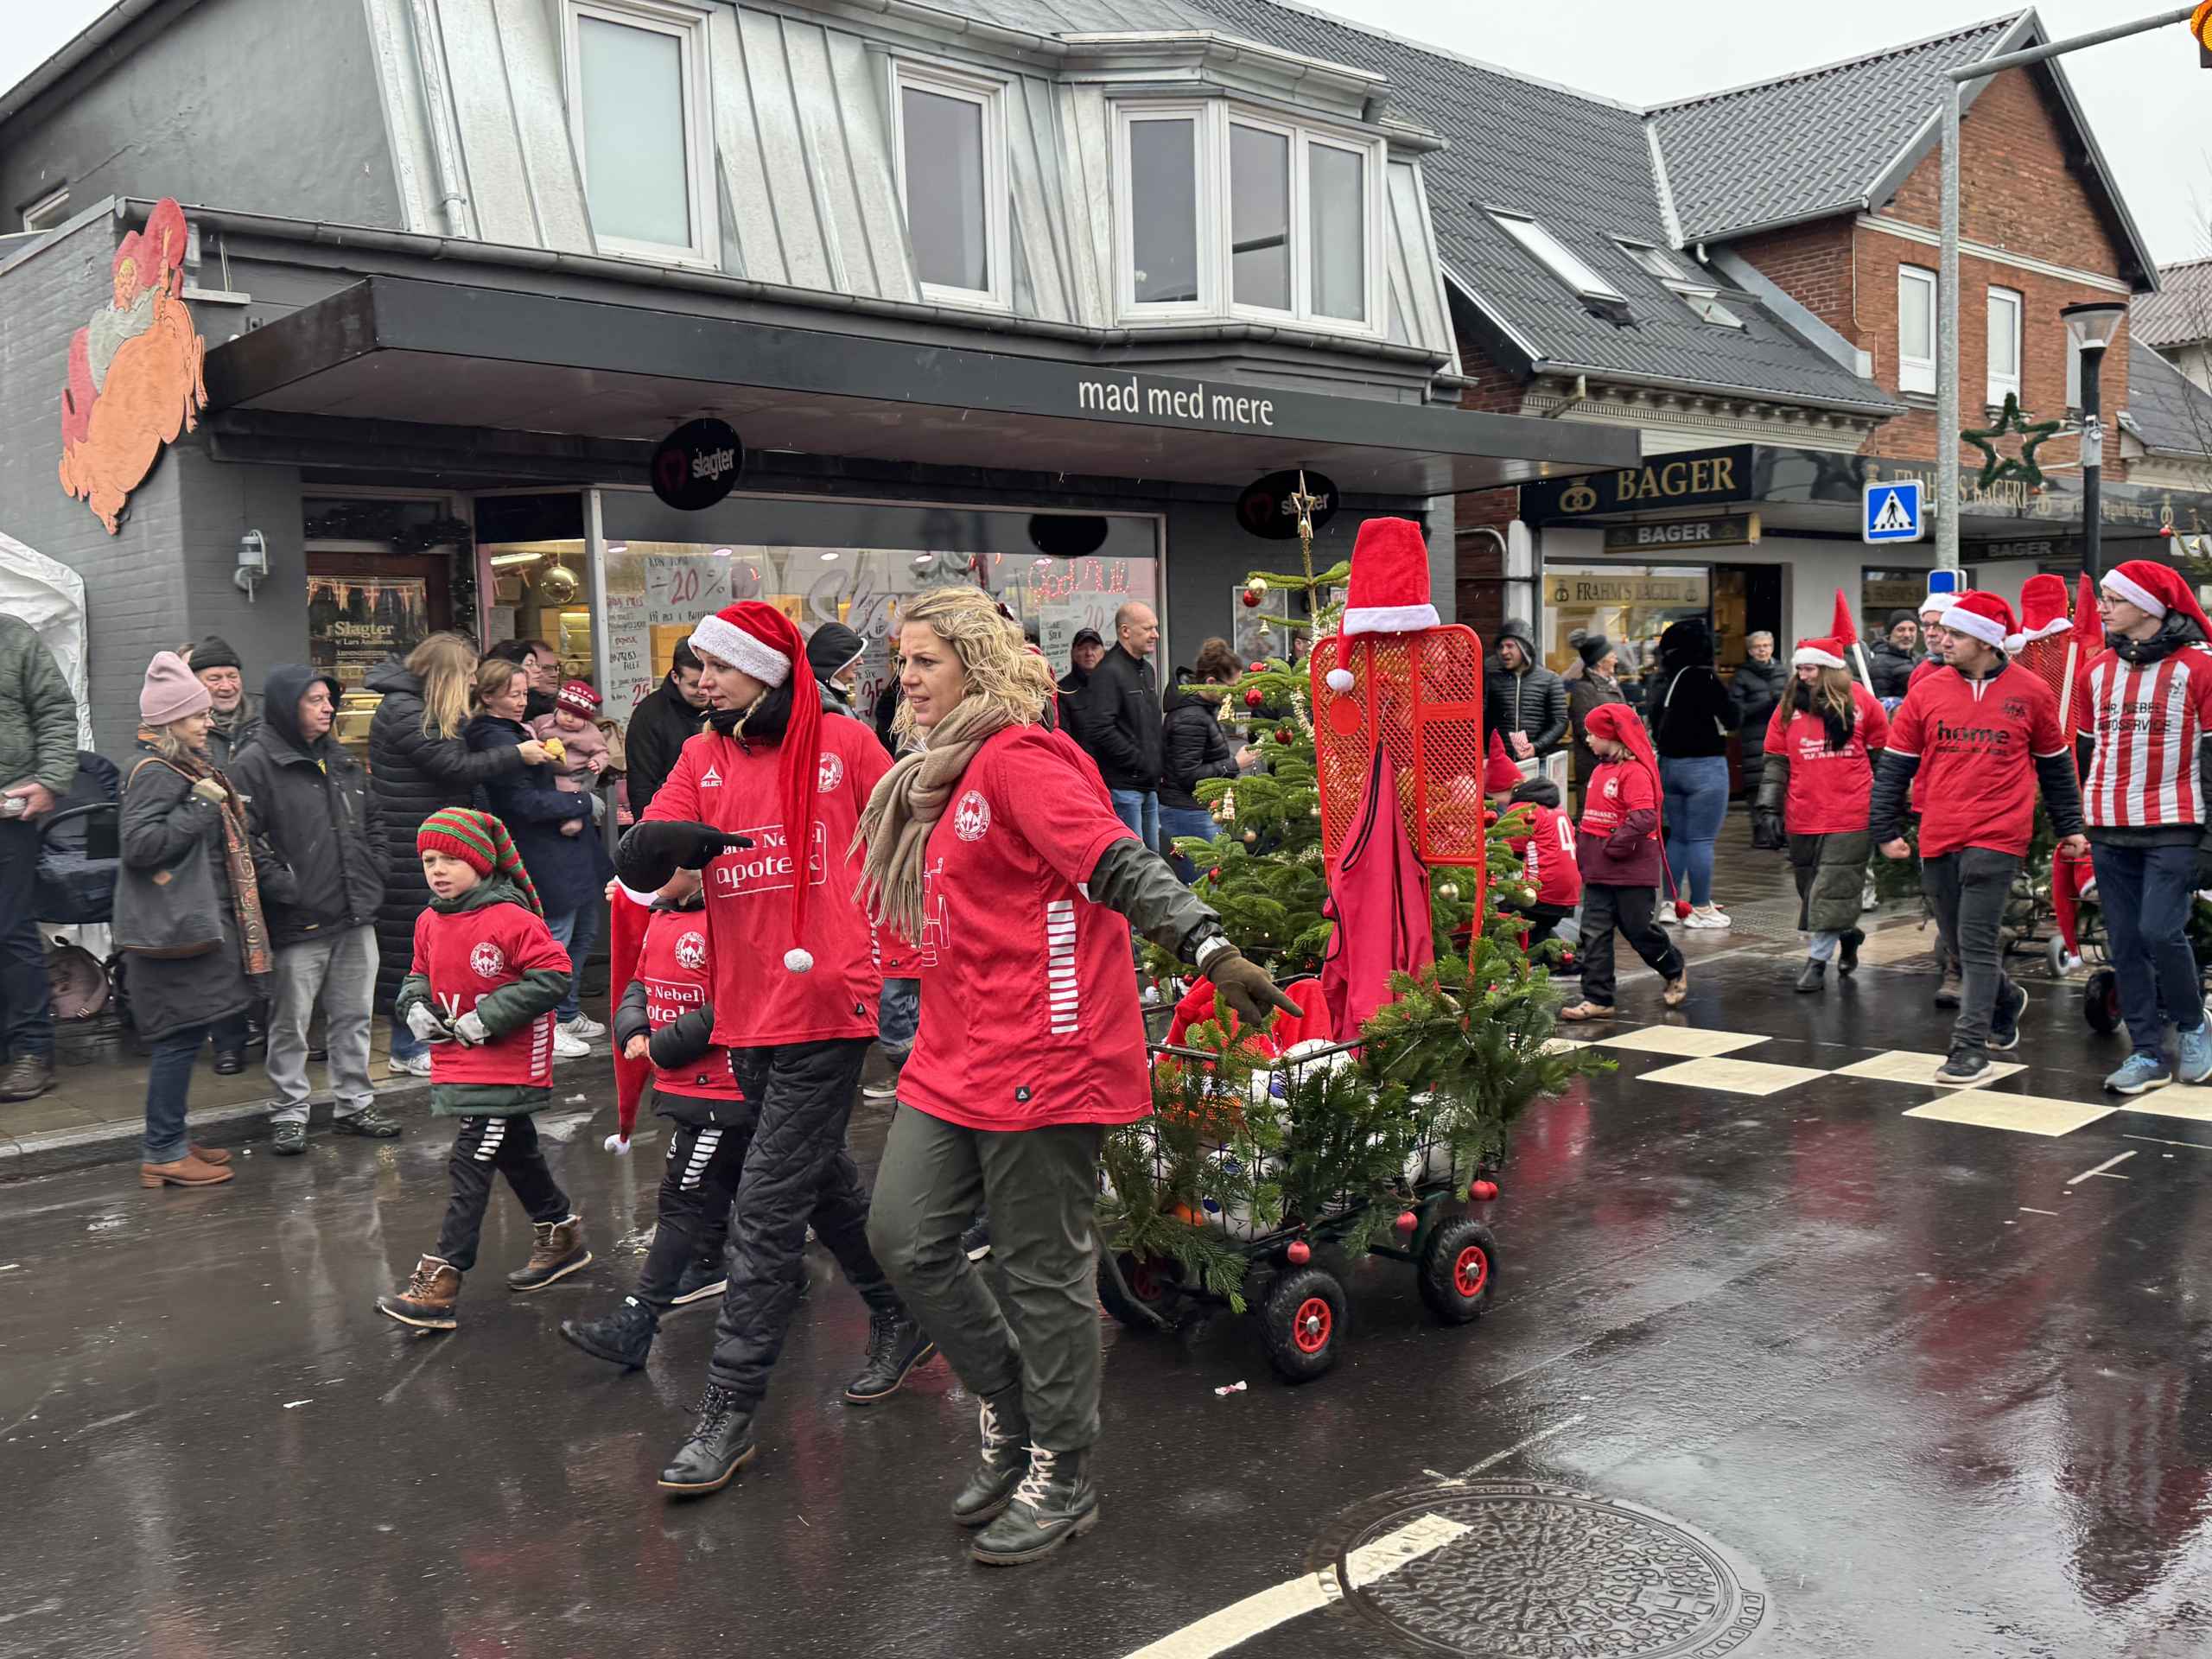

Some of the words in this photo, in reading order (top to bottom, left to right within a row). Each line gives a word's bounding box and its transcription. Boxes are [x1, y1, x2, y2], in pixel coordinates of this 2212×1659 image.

[1079, 376, 1139, 414] mad
[1147, 383, 1204, 420] med
[1212, 394, 1274, 426] mere
[691, 448, 734, 480] slagter
[1617, 457, 1736, 502] BAGER
[1637, 523, 1712, 544] BAGER
[1987, 542, 2053, 561] BAGER
[334, 621, 395, 639] Slagter
[1937, 720, 2011, 745] home
[700, 779, 723, 788] SELECT
[1557, 815, 1577, 861] 4
[655, 985, 700, 1002] Nebel
